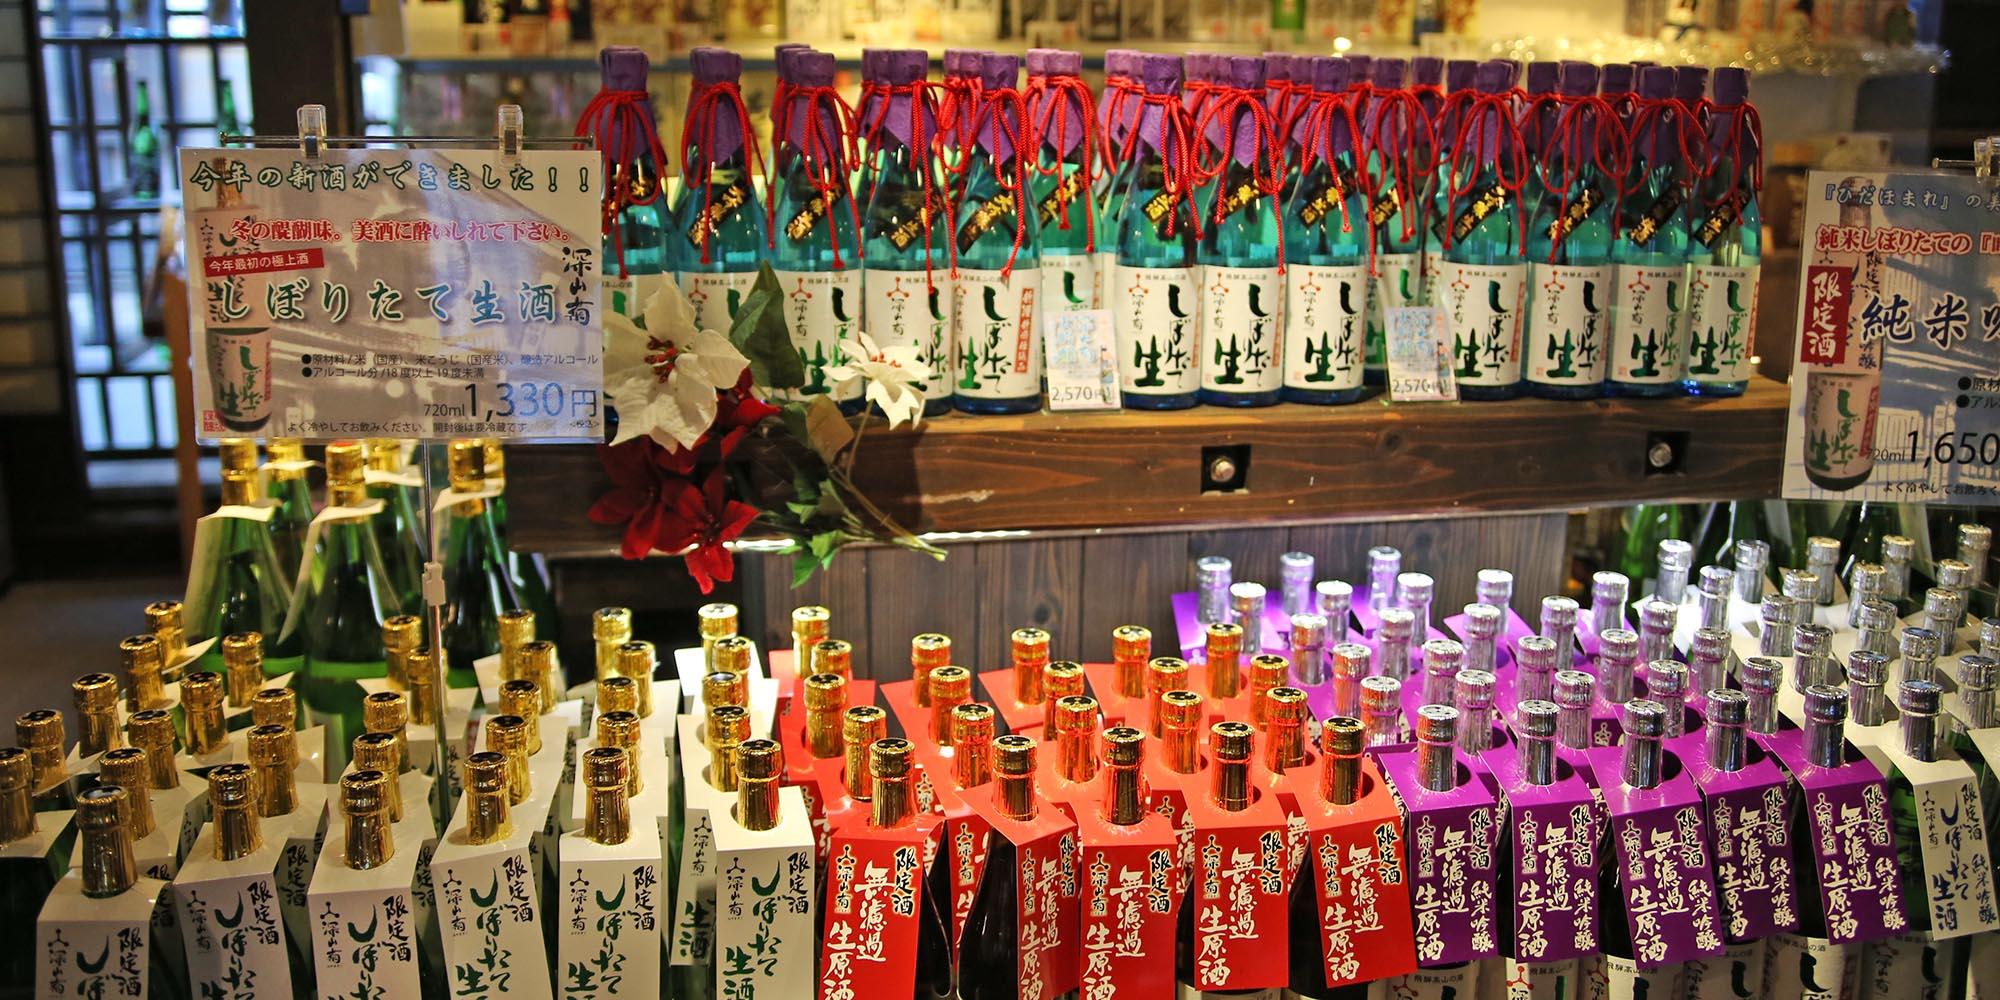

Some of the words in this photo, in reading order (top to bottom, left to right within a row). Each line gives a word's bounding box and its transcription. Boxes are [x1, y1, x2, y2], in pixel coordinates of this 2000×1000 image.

[208, 252, 309, 273] 今年最初の極上酒
[231, 219, 571, 243] 冬の醍醐味。美酒に酔いしれて下さい。
[220, 278, 557, 325] しぼりたて生酒
[1807, 271, 1843, 359] 限定酒
[1134, 333, 1165, 387] 生
[1214, 332, 1245, 385] 生
[1304, 331, 1335, 383] 生
[1454, 327, 1482, 378] 生
[1546, 327, 1577, 378] 生
[1629, 327, 1660, 377] 生
[1688, 325, 1720, 375] 生
[423, 403, 466, 418] 720ml
[1908, 430, 2000, 469] 1,650
[1467, 808, 1493, 869] 限定酒
[1570, 805, 1593, 867] 限定酒
[1676, 808, 1705, 868] 限定酒
[1763, 787, 1787, 846] 限定酒
[1863, 784, 1890, 846] 限定酒
[1939, 792, 1970, 901] しぼりたて
[1960, 783, 1983, 841] 限定酒
[1060, 834, 1076, 898] 限定酒
[1148, 850, 1173, 913] 限定酒
[1258, 832, 1284, 894] 限定酒
[1376, 823, 1403, 884] 限定酒
[1434, 825, 1474, 915] 無濾過
[1537, 821, 1576, 913] 無濾過
[1643, 826, 1690, 916] 無濾過
[1732, 805, 1770, 893] 無濾過
[1835, 802, 1878, 893] 無濾過
[247, 880, 280, 946] 限定酒
[502, 855, 534, 924] 限定酒
[632, 864, 657, 932] 限定酒
[748, 857, 782, 977] しぼりたて
[787, 850, 811, 915] 限定酒
[853, 859, 896, 963] 無濾過
[891, 848, 917, 917] 限定酒
[1035, 856, 1064, 952] 無濾過
[1109, 864, 1151, 958] 無濾過
[1221, 847, 1264, 940] 無濾過
[1340, 842, 1384, 934] 無濾過
[1469, 879, 1495, 953] 純米吟醸
[1573, 877, 1597, 952] 純米吟醸
[1687, 879, 1722, 952] 純米吟醸
[1768, 856, 1796, 928] 純米吟醸
[1823, 860, 1859, 939] 生原酒
[1874, 856, 1906, 931] 純米吟醸
[1932, 874, 1958, 932] 生酒
[1971, 853, 1998, 925] 純米吟醸
[382, 894, 412, 963] 限定酒
[469, 866, 513, 994] しぼりたて
[591, 872, 627, 995] しぼりたて
[1198, 903, 1232, 987] 生原酒
[1324, 901, 1360, 982] 生原酒
[1414, 881, 1446, 962] 生原酒
[1517, 879, 1549, 960] 生原酒
[1630, 884, 1669, 964] 生原酒
[112, 926, 144, 997] 限定酒
